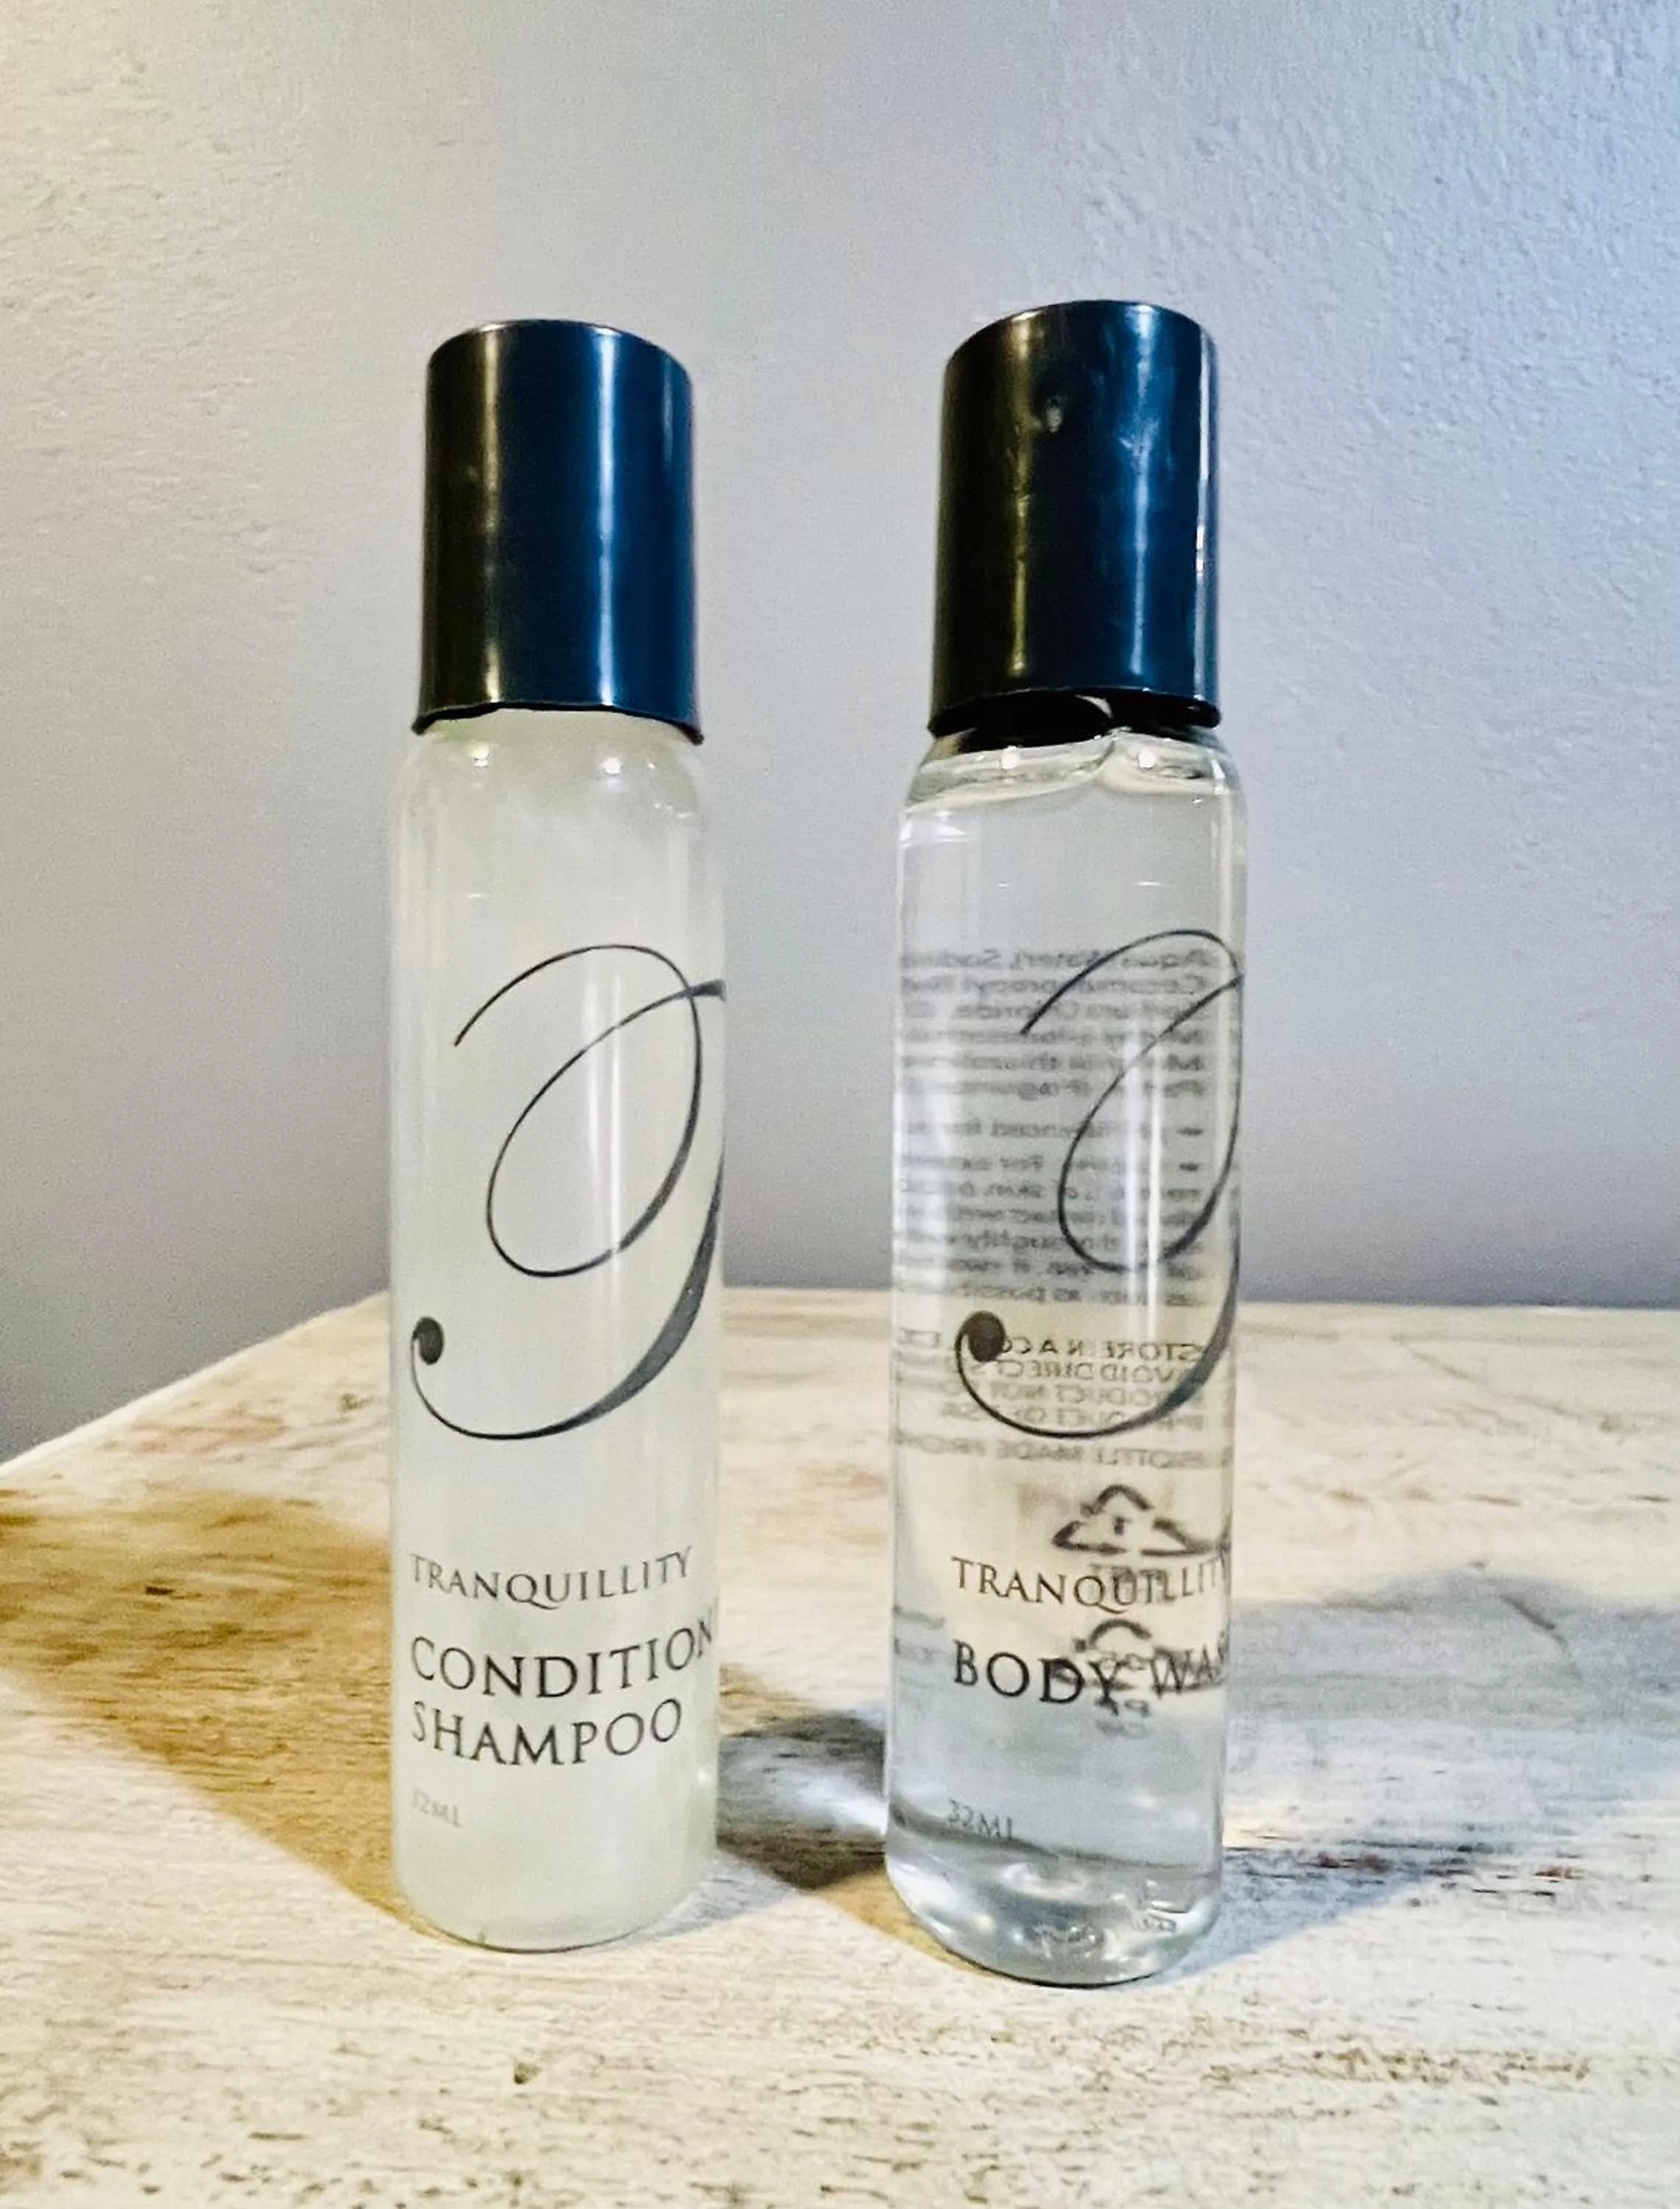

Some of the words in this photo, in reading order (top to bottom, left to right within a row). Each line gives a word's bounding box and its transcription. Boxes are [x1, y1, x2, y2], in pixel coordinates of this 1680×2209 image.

[411, 1545, 693, 1610] TRANQUILLITY
[952, 1638, 1124, 1705] BODY
[412, 1698, 682, 1766] SHAMPOO
